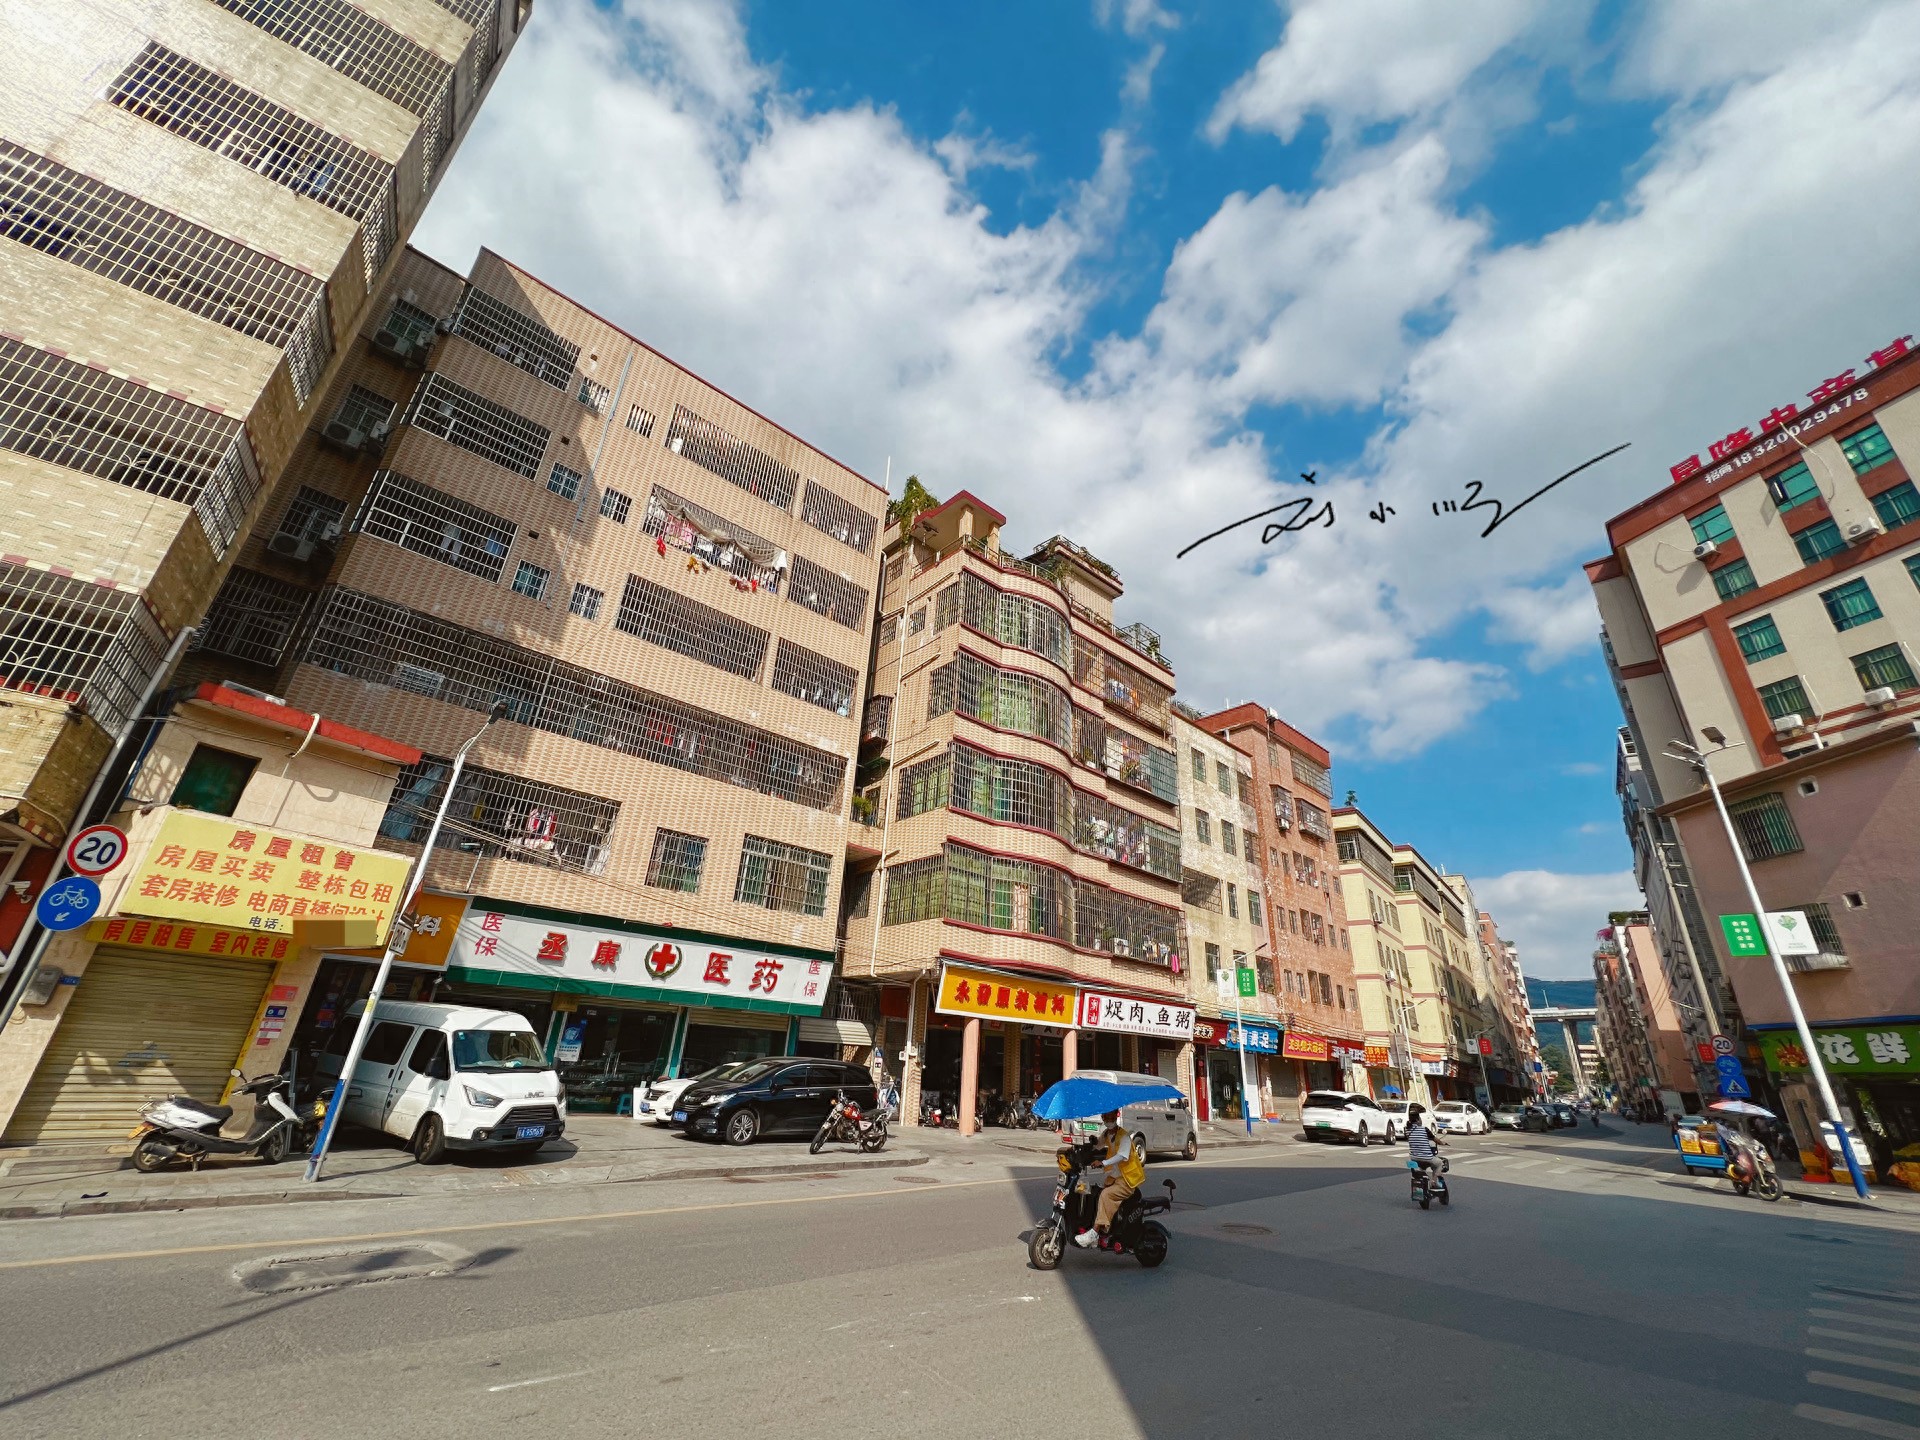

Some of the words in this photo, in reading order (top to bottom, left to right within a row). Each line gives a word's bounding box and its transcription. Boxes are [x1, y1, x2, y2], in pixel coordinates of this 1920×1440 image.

[77, 836, 119, 866] 20
[228, 830, 356, 871] 房屋租售
[139, 874, 241, 907] 套房装修
[154, 845, 276, 884] 房屋买卖
[295, 869, 394, 904] 整栋包租
[102, 919, 197, 950] 房屋租售
[209, 931, 289, 958] 室内装修
[474, 912, 505, 957] 医保
[803, 958, 824, 998] 医保
[1714, 1039, 1731, 1050] 20
[1816, 1030, 1911, 1065] 花鲜
